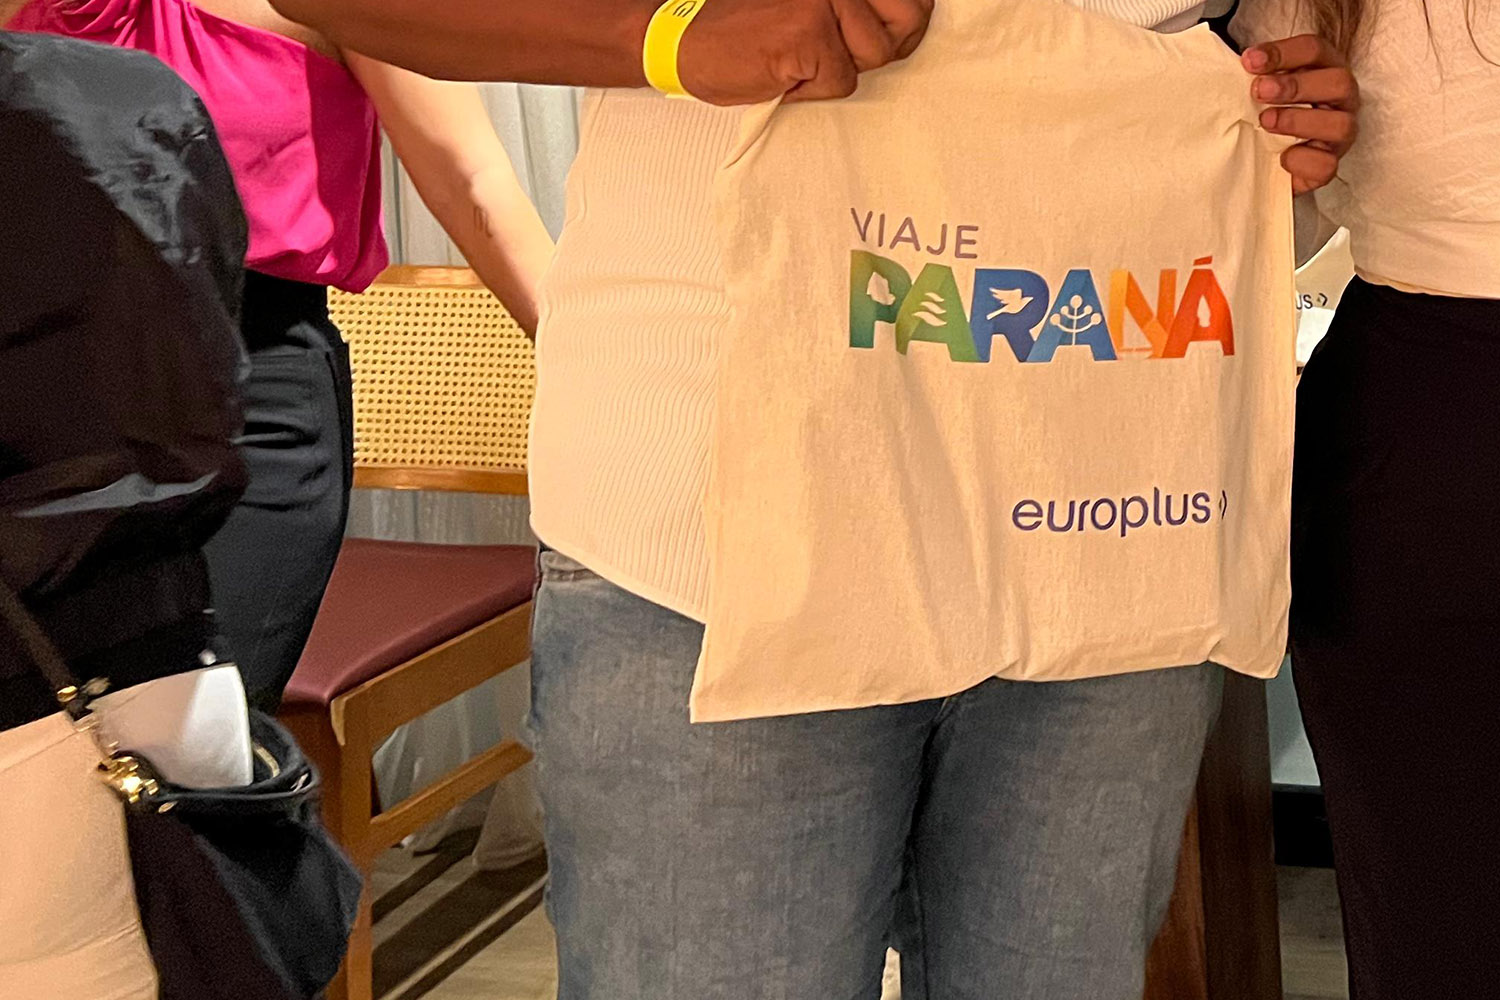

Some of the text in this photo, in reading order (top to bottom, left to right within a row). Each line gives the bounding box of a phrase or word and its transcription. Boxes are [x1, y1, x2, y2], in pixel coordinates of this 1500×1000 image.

[851, 207, 979, 259] VIAJE
[850, 249, 1235, 363] PARANÁ
[1012, 486, 1212, 538] europlus
